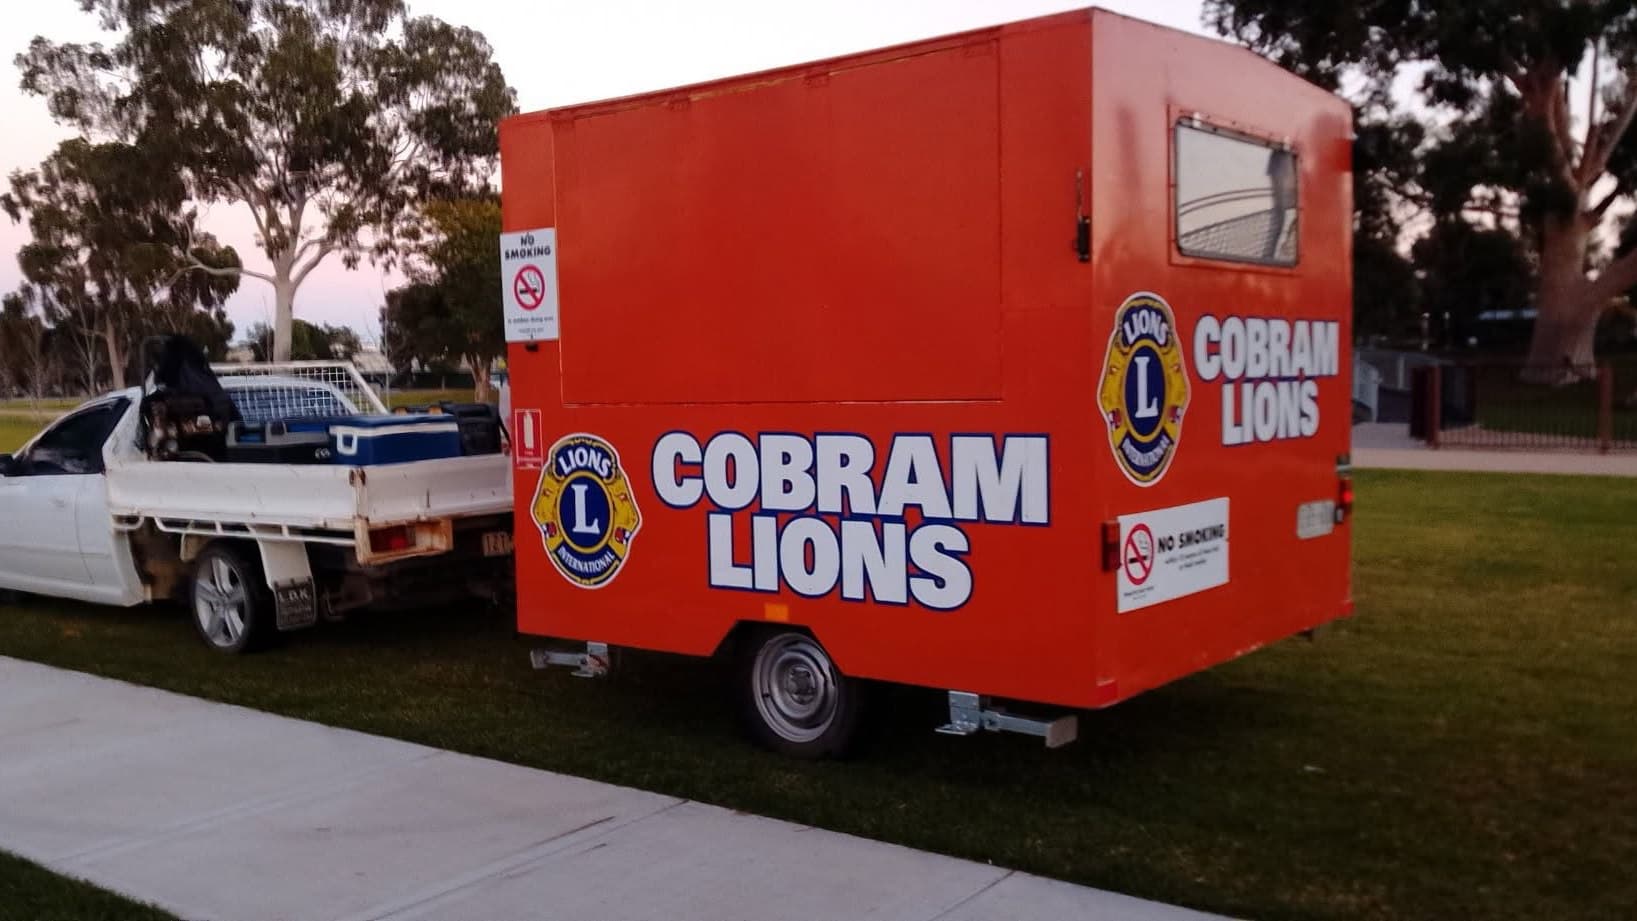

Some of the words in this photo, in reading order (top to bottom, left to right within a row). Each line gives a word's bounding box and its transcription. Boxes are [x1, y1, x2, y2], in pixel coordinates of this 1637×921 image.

[505, 246, 552, 260] SMOKING
[520, 235, 535, 246] NO
[1123, 309, 1168, 345] LIONS
[1194, 315, 1340, 380] COBRAM
[1134, 356, 1158, 418] L
[1221, 380, 1320, 447] LIONS
[558, 447, 611, 478] LIONS
[652, 430, 1050, 526] COBRAM
[571, 484, 600, 534] L
[1158, 535, 1175, 553] NO
[1179, 524, 1224, 549] SMOKING
[557, 548, 616, 574] INTERNATIONAL
[708, 512, 974, 611] LIONS
